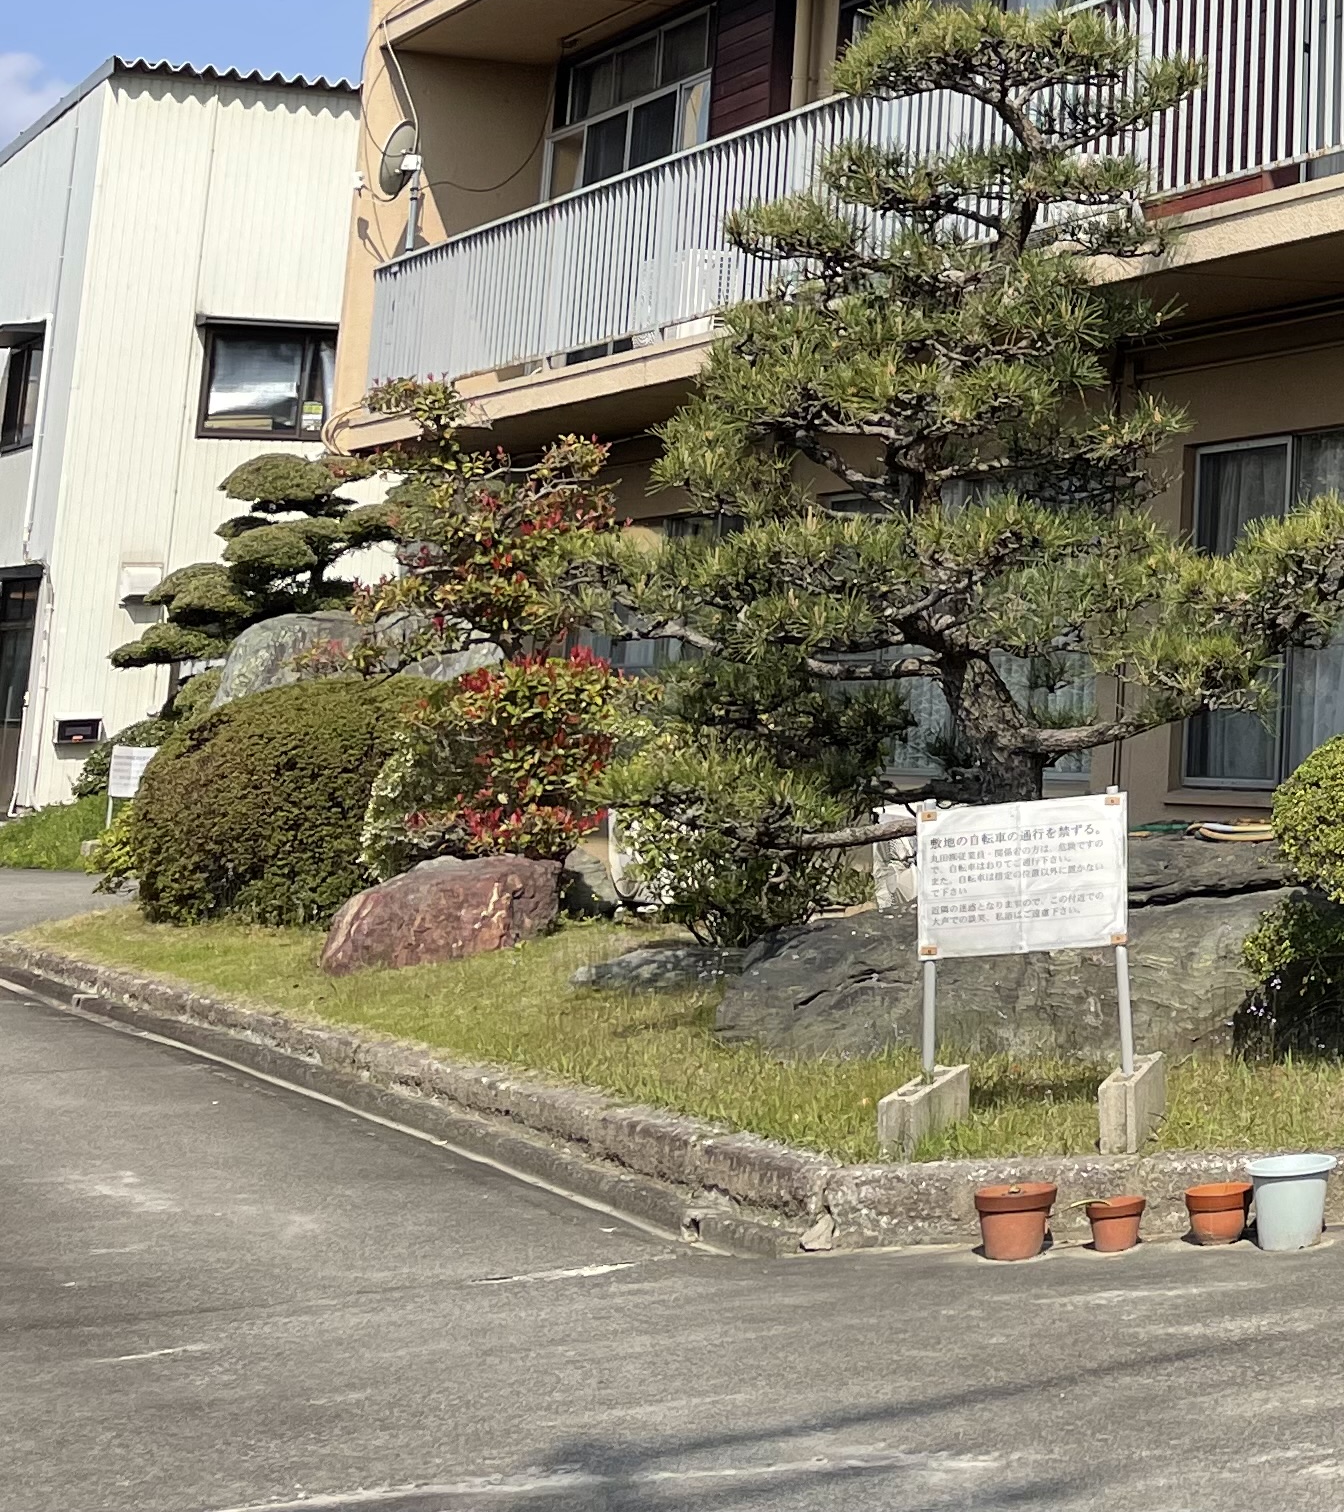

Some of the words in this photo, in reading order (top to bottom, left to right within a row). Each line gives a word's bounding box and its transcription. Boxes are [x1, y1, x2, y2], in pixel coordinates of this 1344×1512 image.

[930, 824, 1100, 850] 敷地の自転車の通行を禁ずる。
